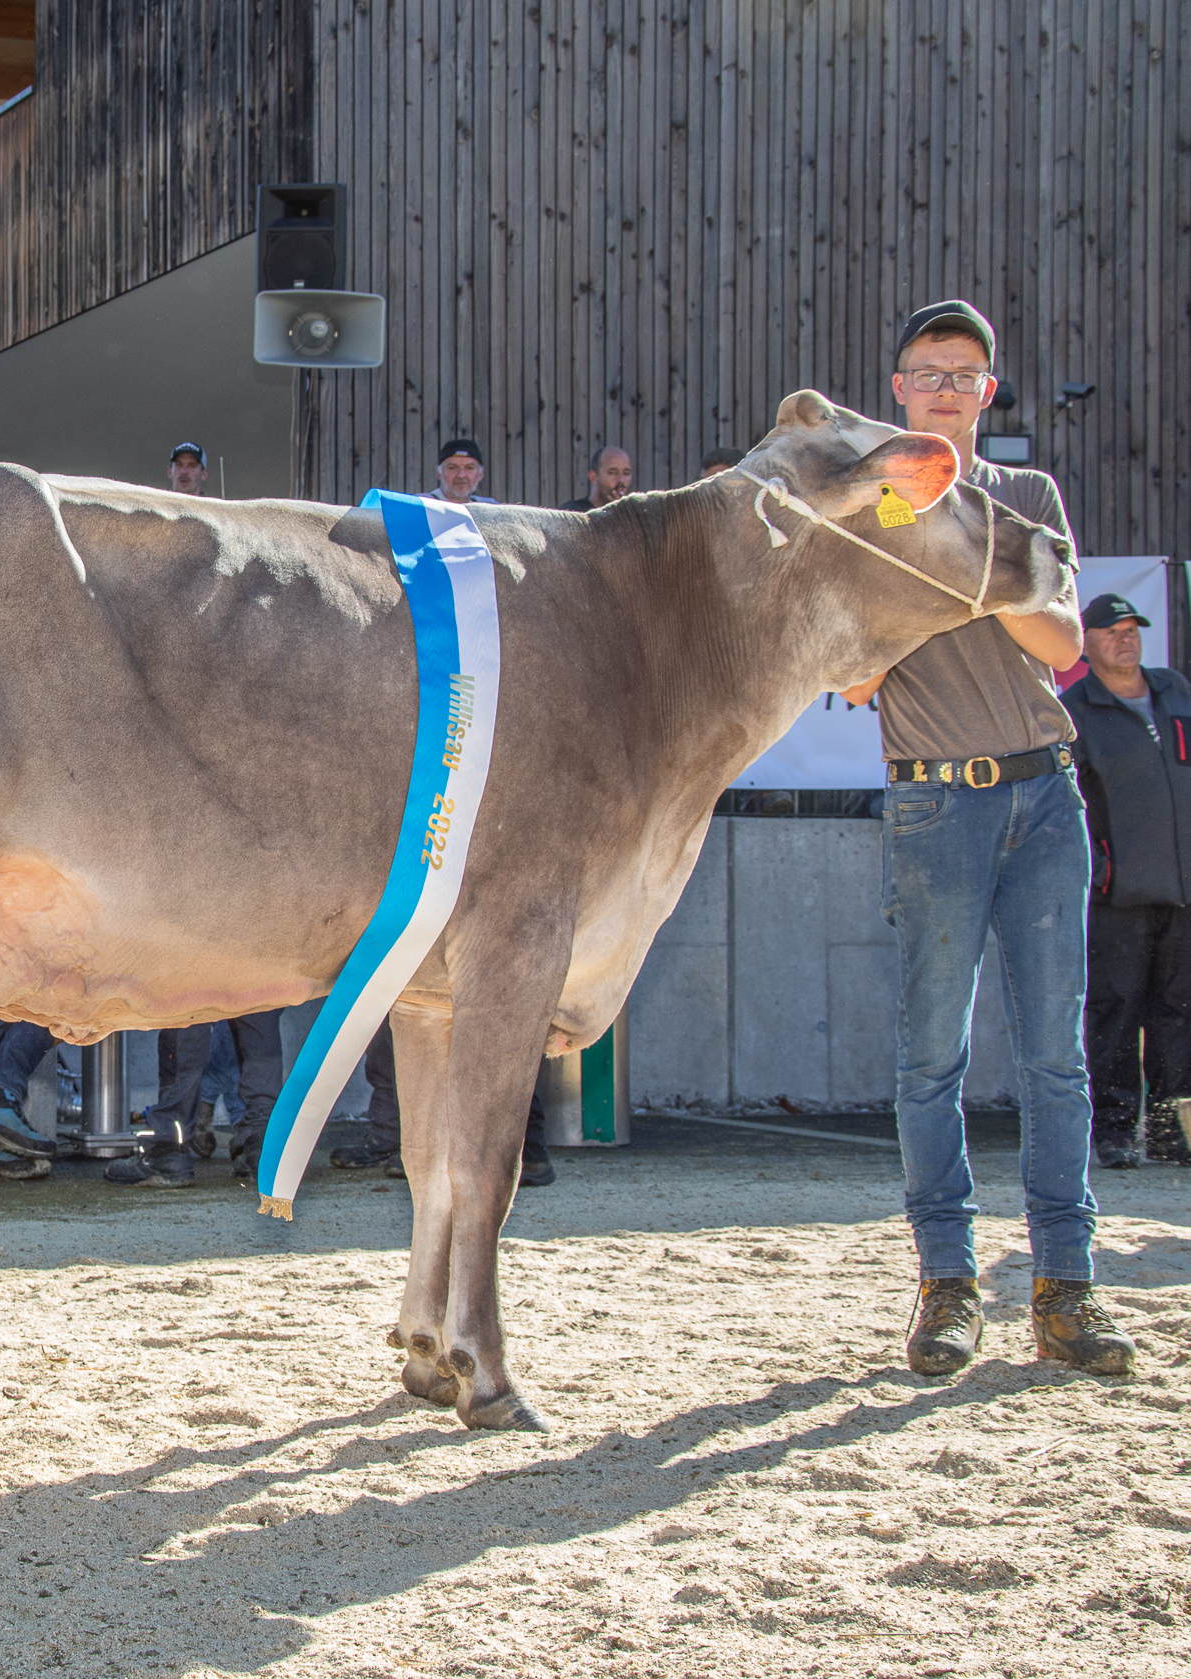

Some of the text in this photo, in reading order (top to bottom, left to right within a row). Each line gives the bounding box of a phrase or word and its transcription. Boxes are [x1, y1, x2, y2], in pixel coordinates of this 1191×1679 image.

[883, 512, 910, 526] 6028
[421, 673, 475, 871] Willisau 2022
